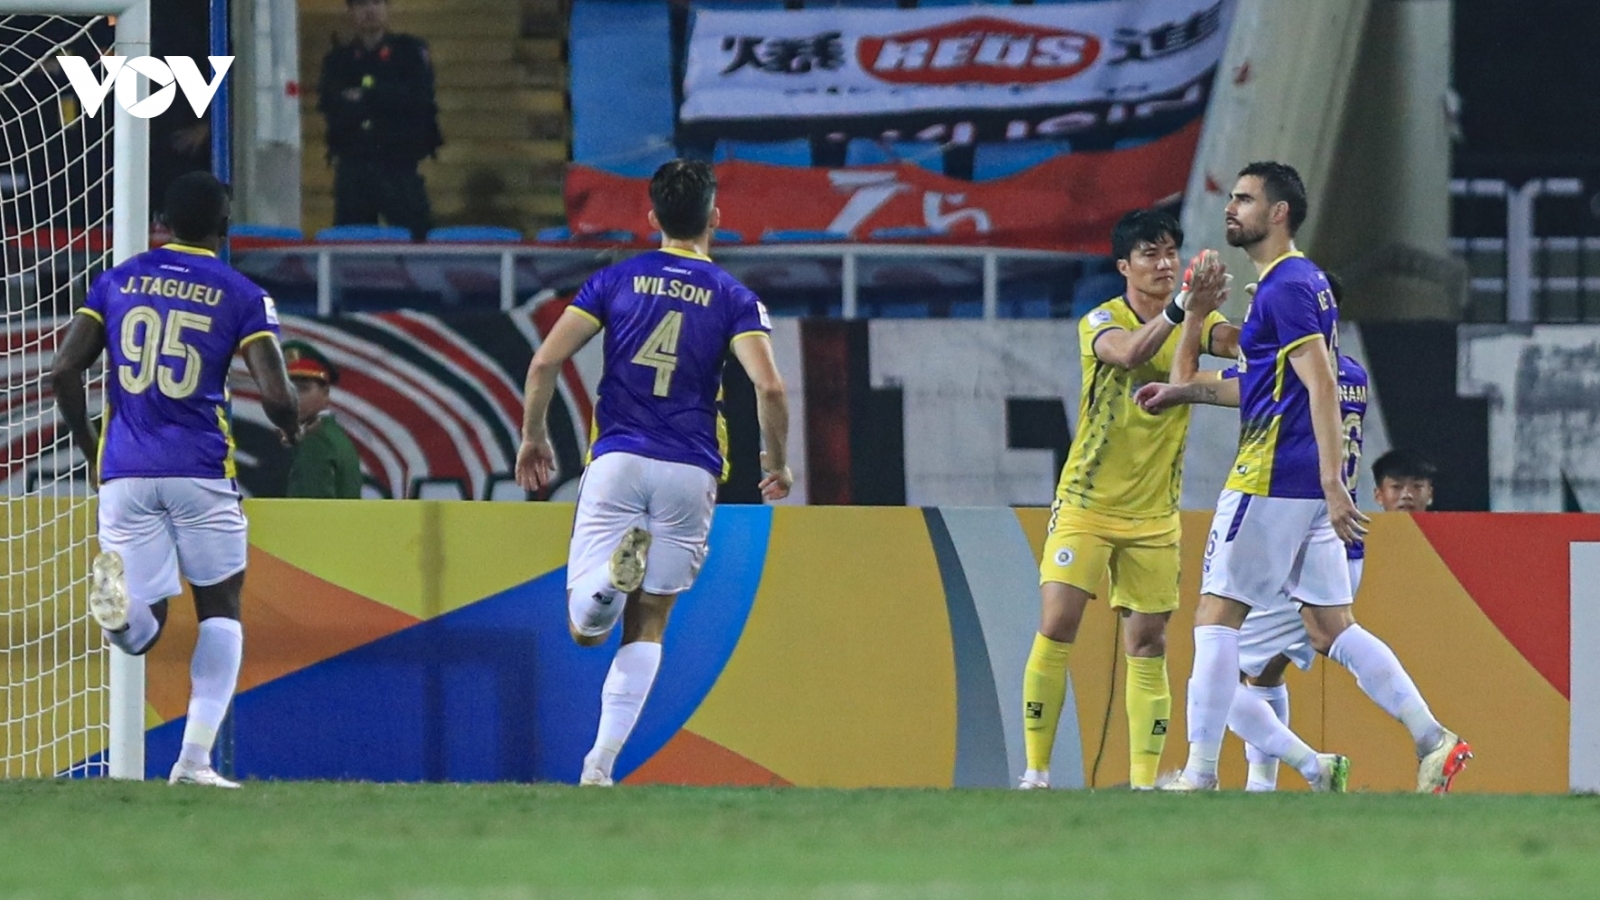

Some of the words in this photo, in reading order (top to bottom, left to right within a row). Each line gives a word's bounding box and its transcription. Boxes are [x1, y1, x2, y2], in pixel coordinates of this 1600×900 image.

[120, 276, 222, 306] J.TAGUEU
[633, 275, 712, 307] WILSON
[118, 305, 212, 399] 95
[631, 310, 683, 398] 4
